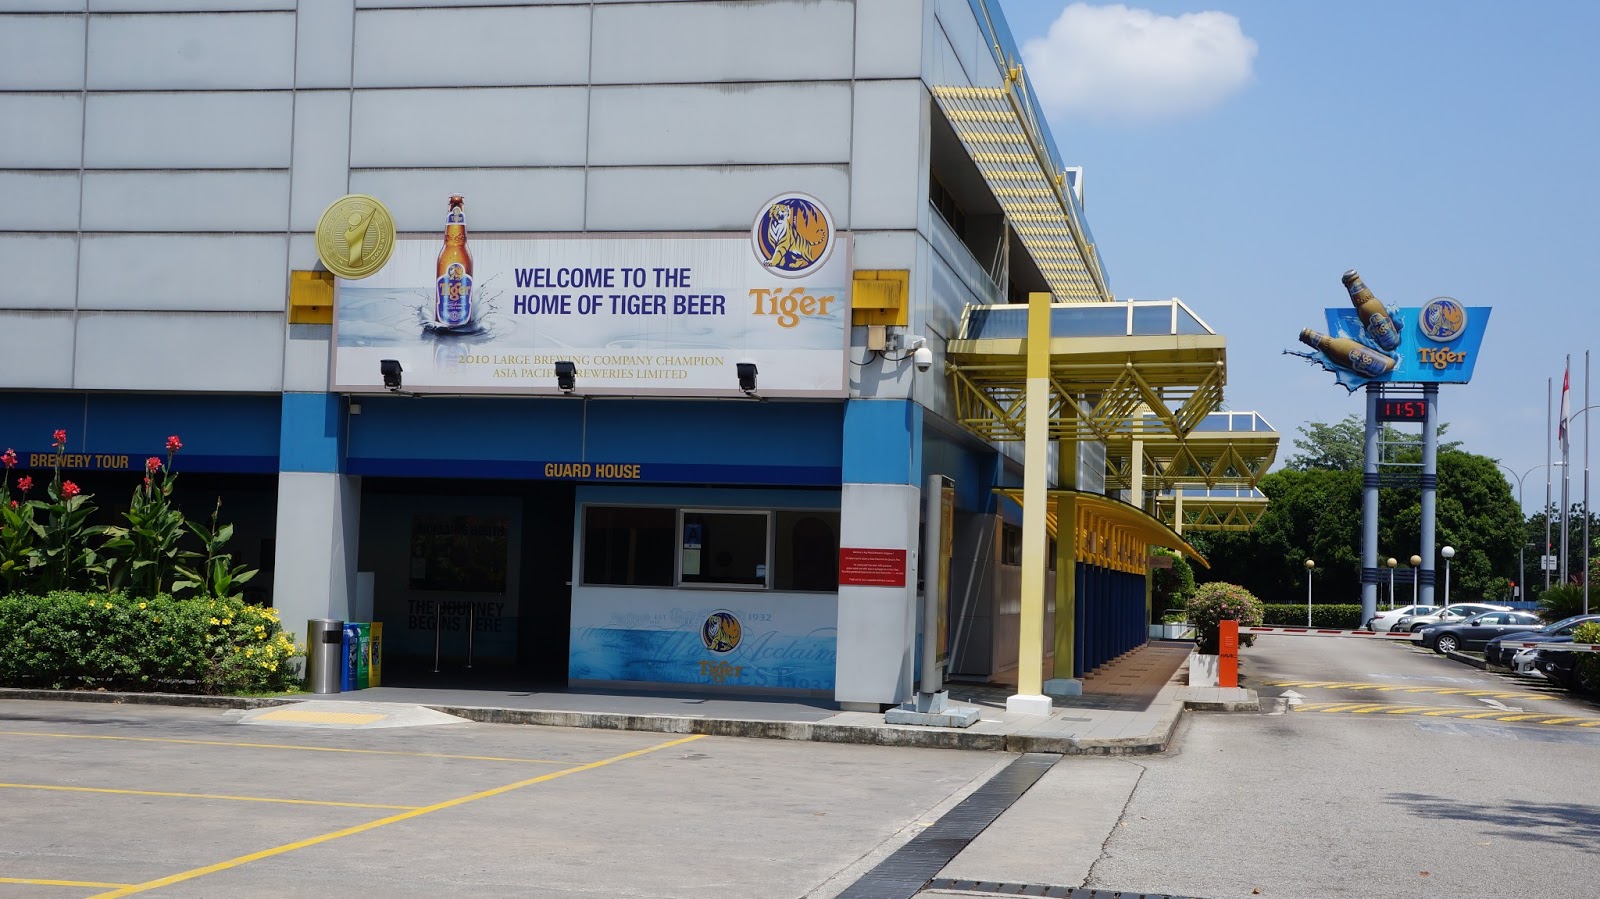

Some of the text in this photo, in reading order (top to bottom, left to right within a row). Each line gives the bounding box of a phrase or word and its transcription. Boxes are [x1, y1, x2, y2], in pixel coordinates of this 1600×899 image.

[514, 267, 691, 288] WELCOME TO THE
[440, 281, 470, 301] Tiger
[513, 294, 725, 315] HOME OF TIGER BEER
[748, 286, 835, 328] Tiger
[458, 354, 725, 367] 2010 LARGE BREWING COMPANY CHAMPION
[1418, 346, 1467, 369] Tiger
[492, 368, 688, 380] ASIA PACIF REWERIES LIMITED
[1385, 401, 1425, 417] 11:57
[30, 453, 129, 469] BREWERY TOUR
[544, 463, 641, 479] GUARD HOUSE
[408, 599, 504, 617] THE JOURNEY
[408, 615, 461, 632] BEGNS
[748, 613, 772, 621] 1932
[699, 660, 743, 683] Tiger
